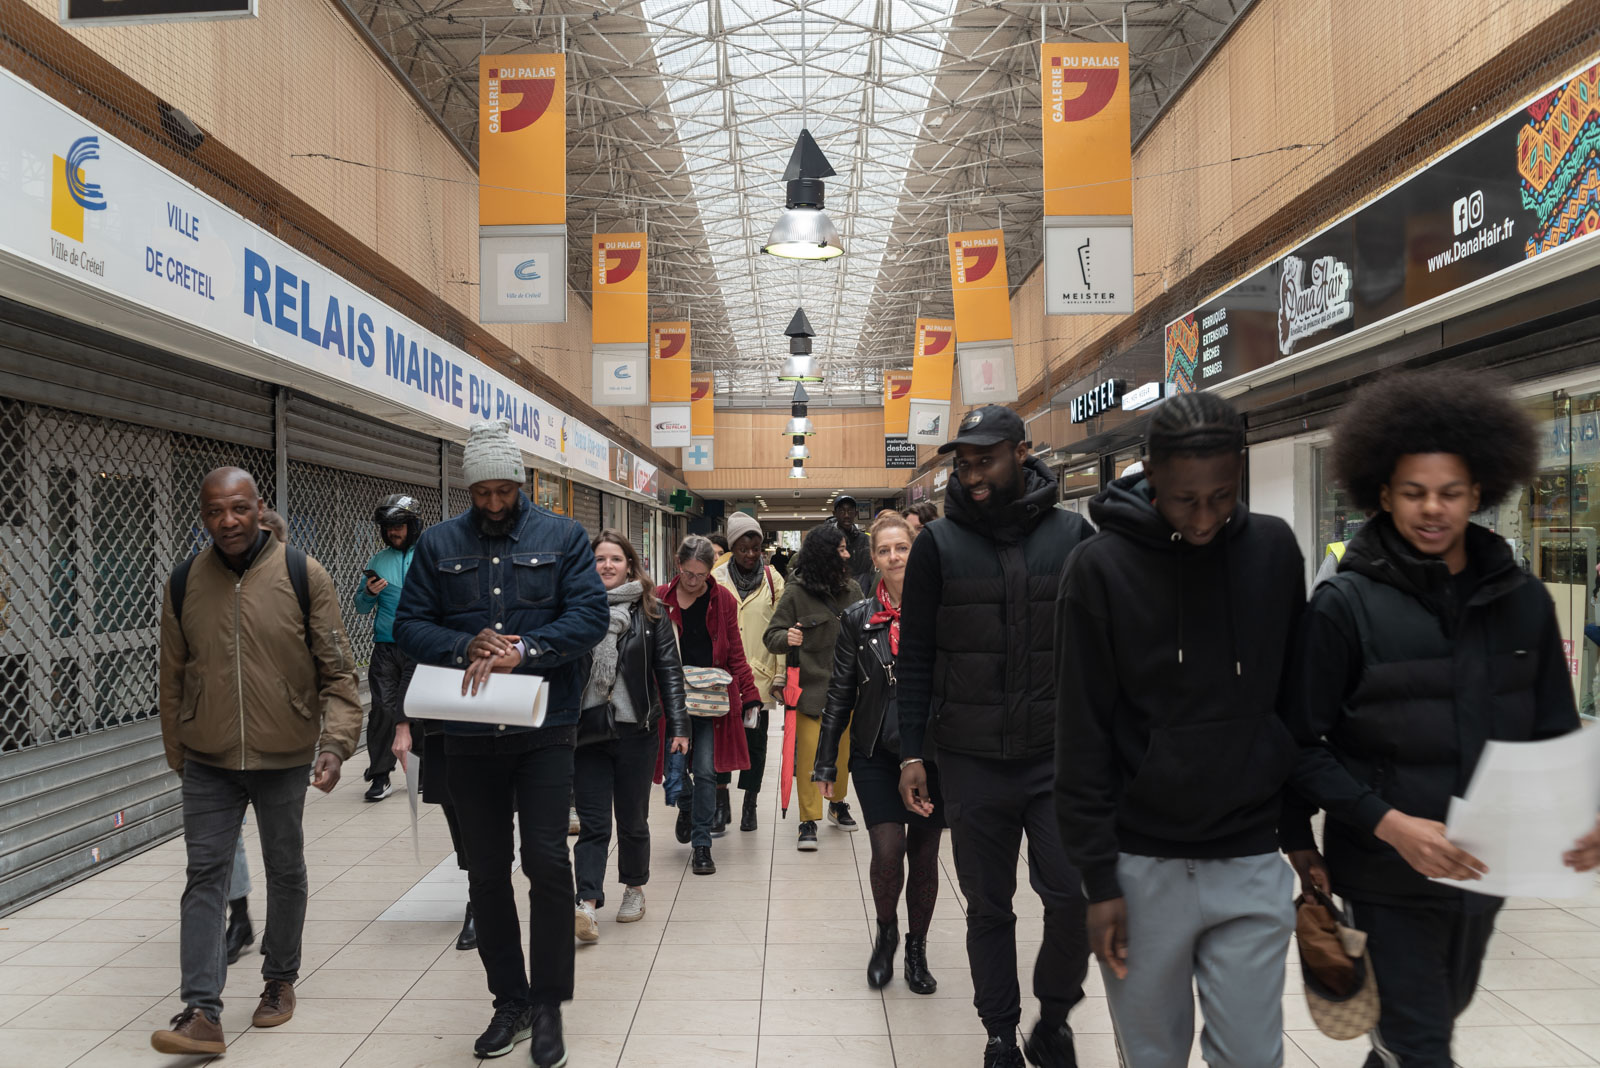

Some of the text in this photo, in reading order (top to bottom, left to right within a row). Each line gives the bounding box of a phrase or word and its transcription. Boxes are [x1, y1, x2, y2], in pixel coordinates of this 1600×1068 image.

[500, 67, 556, 78] DU PALAIS
[1063, 56, 1119, 67] DU PALAIS
[489, 80, 499, 133] GALERIE
[1051, 68, 1063, 123] GALERIE
[167, 202, 199, 242] VILLE
[51, 237, 105, 277] Ville de Créteil
[617, 241, 641, 249] PALAIS
[961, 238, 999, 248] DU PALAIS
[1427, 217, 1515, 273] www.DanaHair.fr
[146, 246, 215, 301] DE CRETEIL
[598, 250, 606, 285] GALERIE
[955, 248, 965, 284] GALERIE
[1062, 292, 1115, 300] MEISTER
[1202, 307, 1226, 331] PERRUQUES
[243, 247, 375, 368] RELAIS
[385, 325, 463, 409] MAIRIE
[469, 373, 491, 420] DU
[496, 388, 540, 442] PALAIS
[1202, 324, 1229, 346] EXTENSIONS
[1202, 345, 1220, 363] MÈCHES
[1202, 361, 1223, 379] TISSAGES
[1070, 378, 1115, 424] MEISTER
[887, 444, 915, 452] destock
